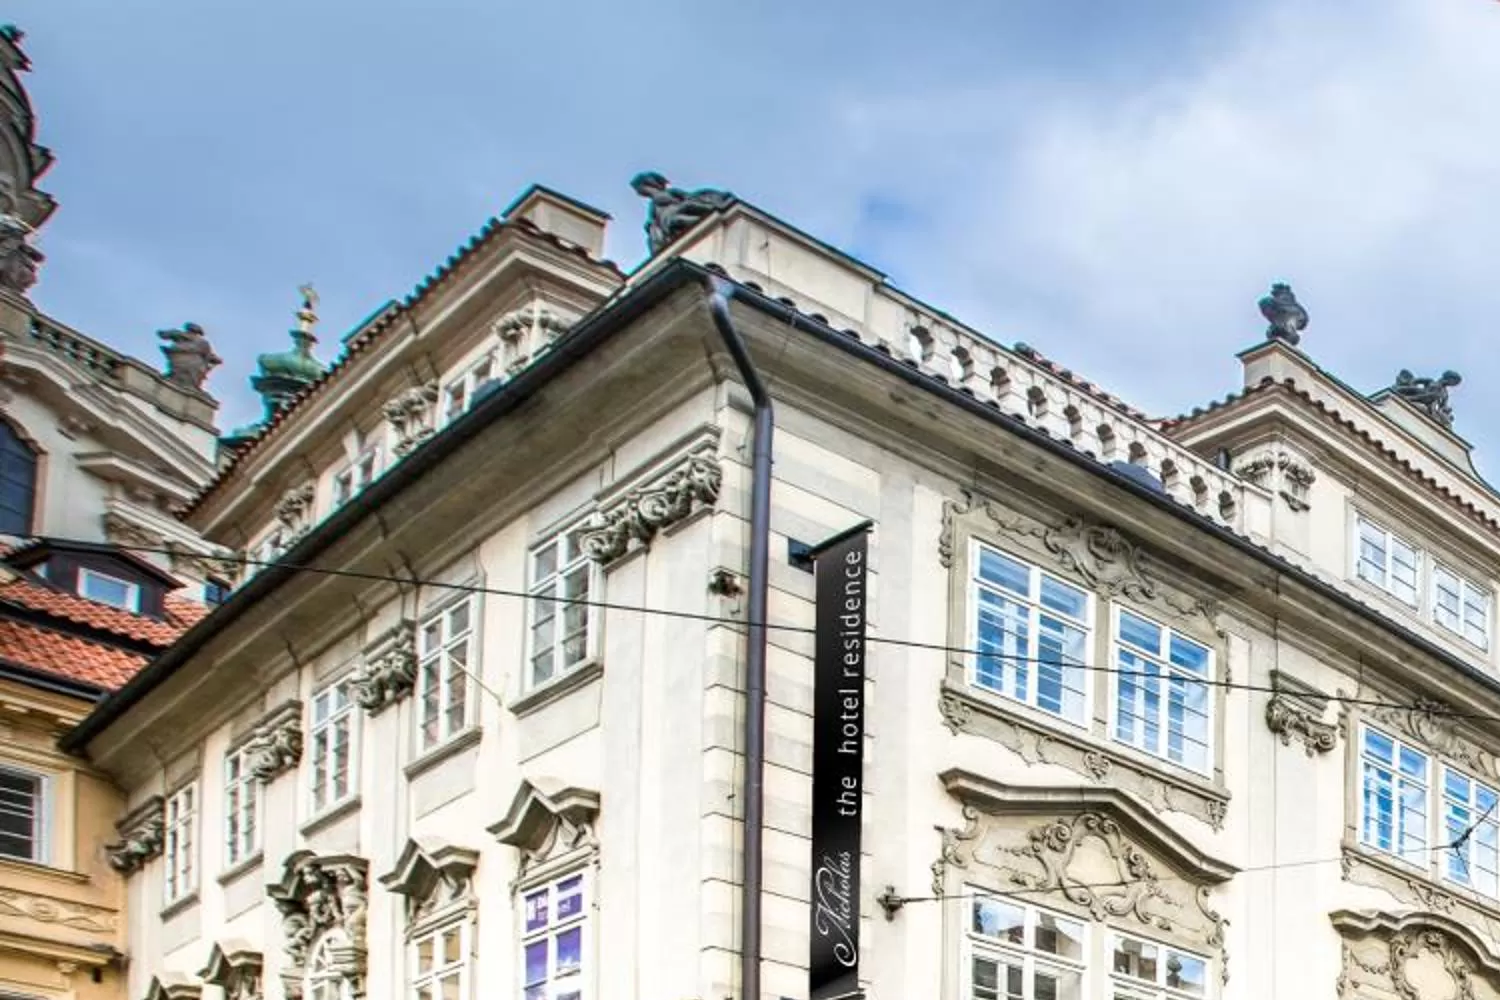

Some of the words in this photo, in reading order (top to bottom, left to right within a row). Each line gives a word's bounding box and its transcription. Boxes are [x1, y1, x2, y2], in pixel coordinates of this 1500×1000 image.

[840, 551, 862, 677] residence
[838, 689, 859, 754] hotel
[836, 776, 857, 816] the
[816, 851, 857, 967] Nicholas
